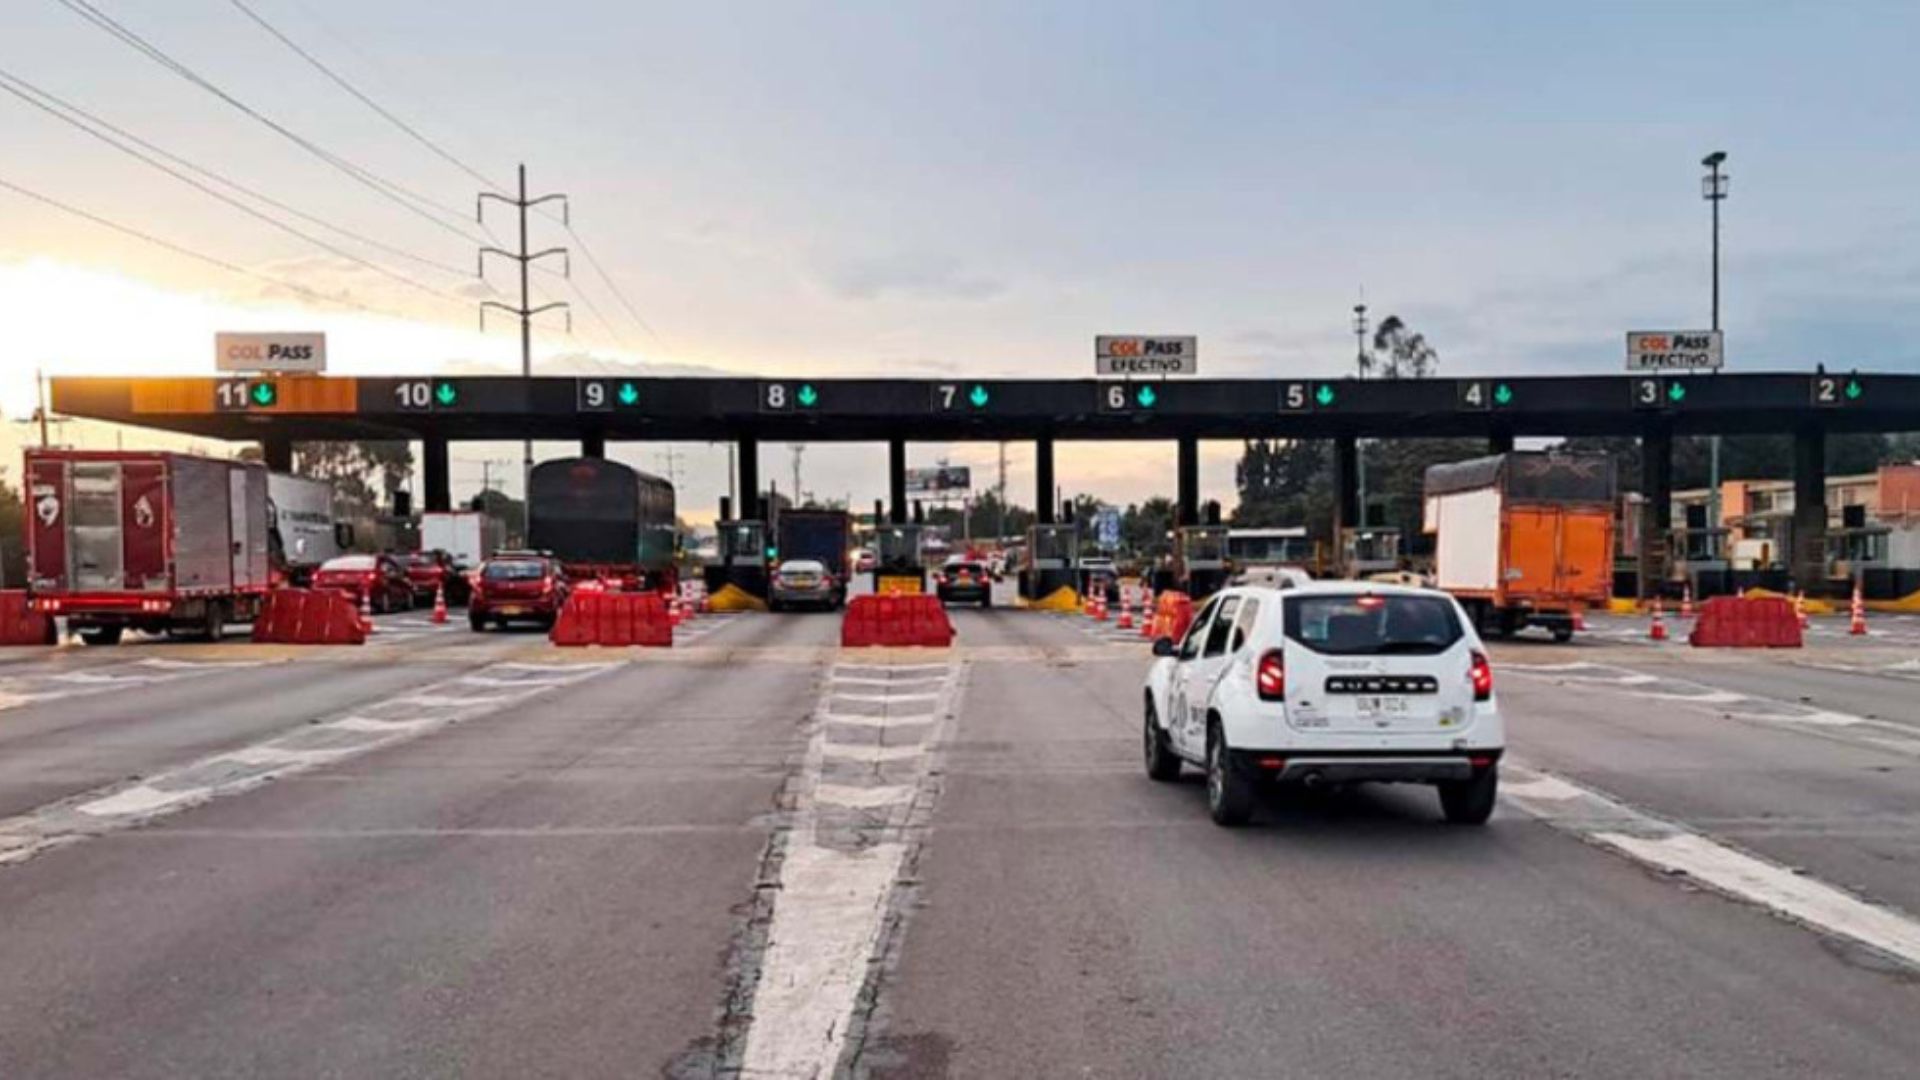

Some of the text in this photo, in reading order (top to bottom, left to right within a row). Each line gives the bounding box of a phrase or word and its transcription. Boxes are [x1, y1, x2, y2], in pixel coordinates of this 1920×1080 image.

[1110, 359, 1183, 372] EFECTIVO
[1640, 352, 1710, 366] EFECTIVO
[217, 382, 247, 406] 11
[396, 383, 430, 407] 10
[586, 383, 604, 406] 9
[768, 384, 786, 407] 8
[939, 385, 956, 408] 7
[1108, 385, 1125, 408] 6
[1286, 384, 1304, 408] 5
[1465, 383, 1482, 404] 4
[1640, 380, 1656, 403] 3
[1818, 379, 1835, 401] 2
